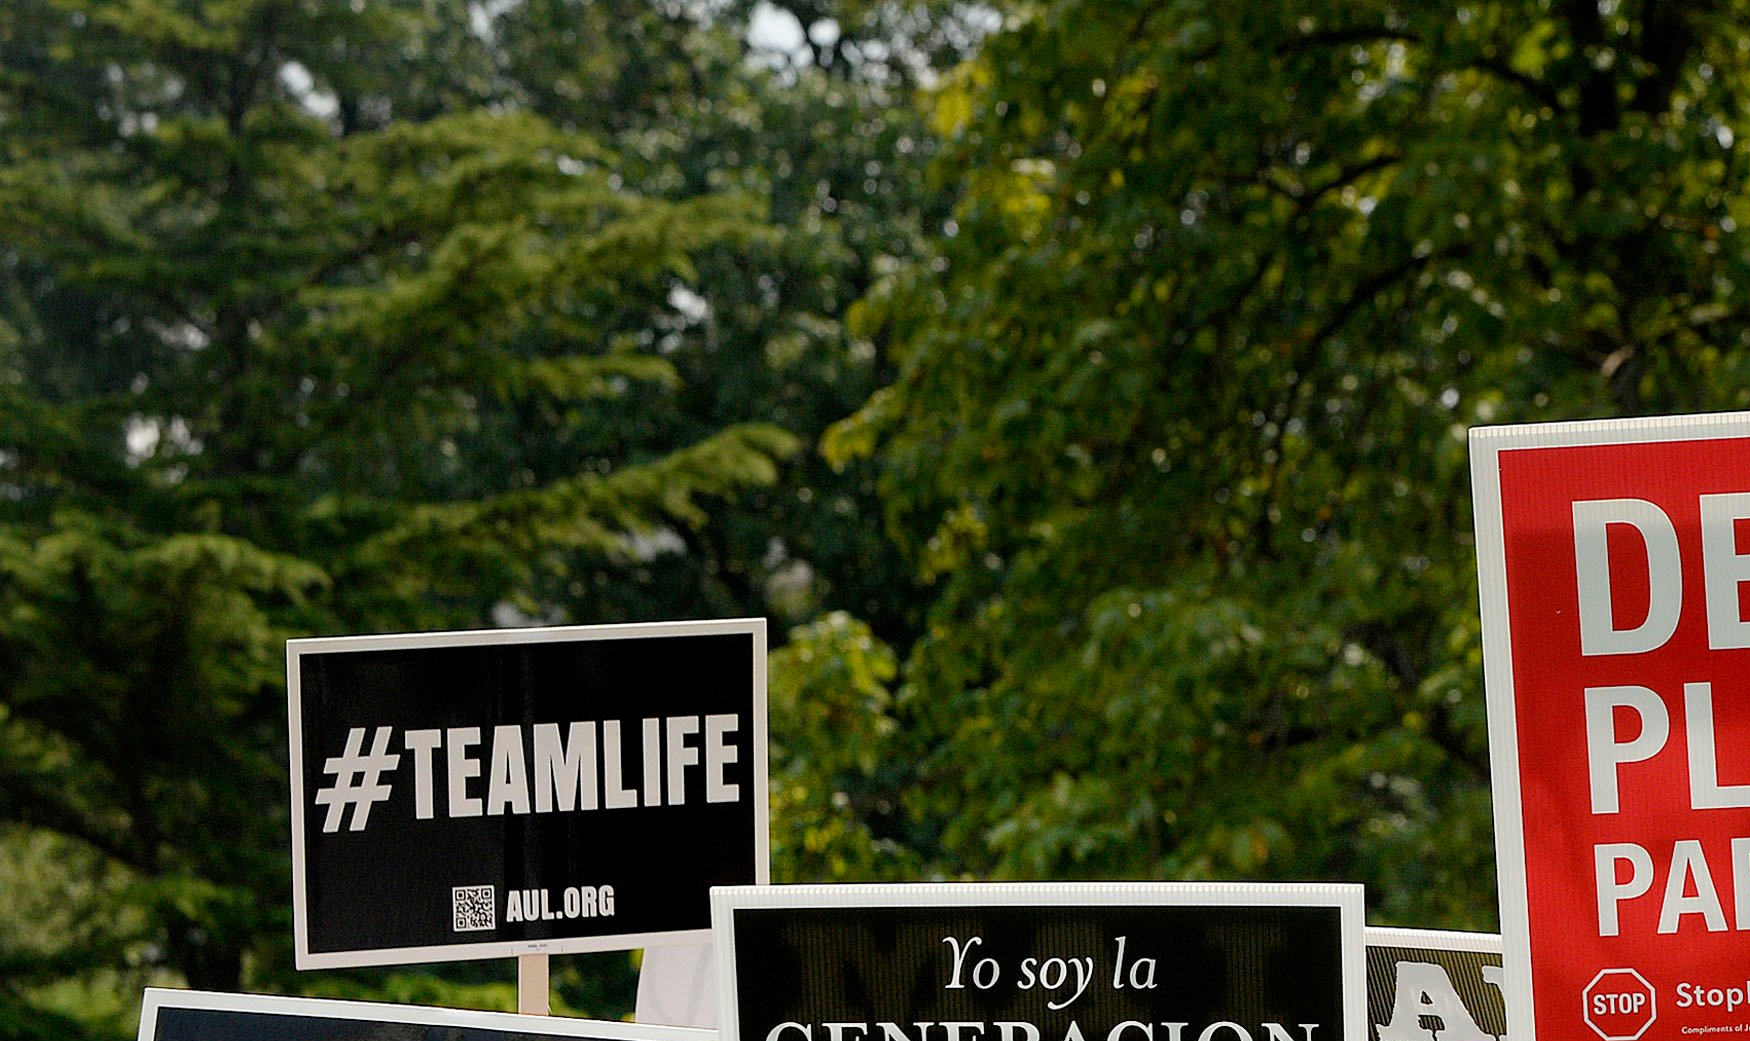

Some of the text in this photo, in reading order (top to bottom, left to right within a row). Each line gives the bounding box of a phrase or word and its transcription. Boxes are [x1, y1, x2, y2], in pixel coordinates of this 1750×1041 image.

[314, 713, 740, 833] #TEAMLIFE
[506, 885, 615, 922] AUL.ORG
[942, 936, 1157, 1010] Yo soy la
[1593, 993, 1646, 1015] STOP
[1681, 1025, 1733, 1035] Compliments
